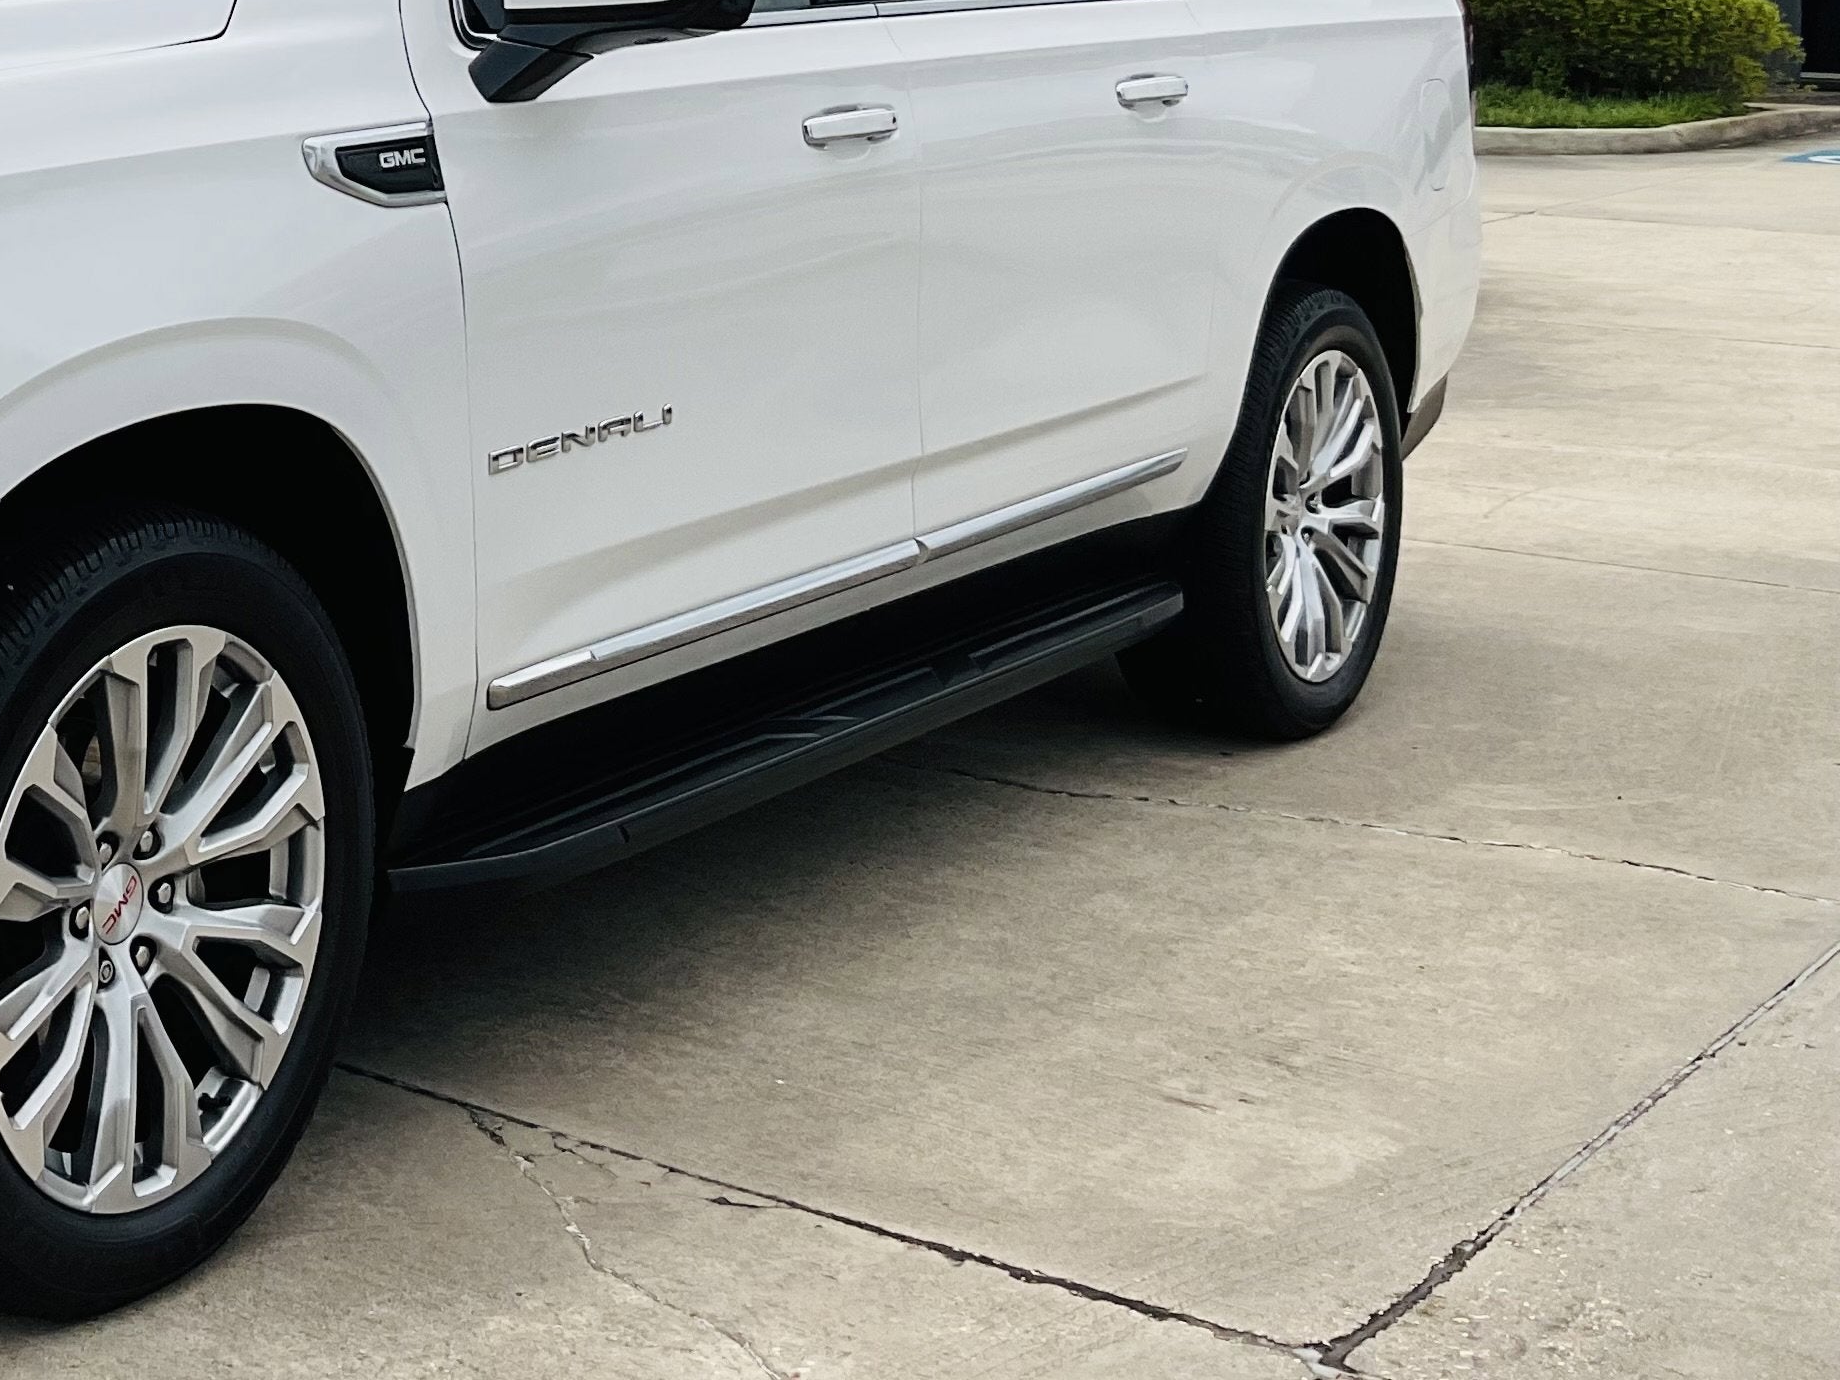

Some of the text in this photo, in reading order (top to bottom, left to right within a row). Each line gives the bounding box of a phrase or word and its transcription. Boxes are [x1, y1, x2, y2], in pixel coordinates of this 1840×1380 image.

[379, 147, 426, 169] GMC
[488, 403, 673, 476] DENALI
[102, 875, 137, 935] GMC
